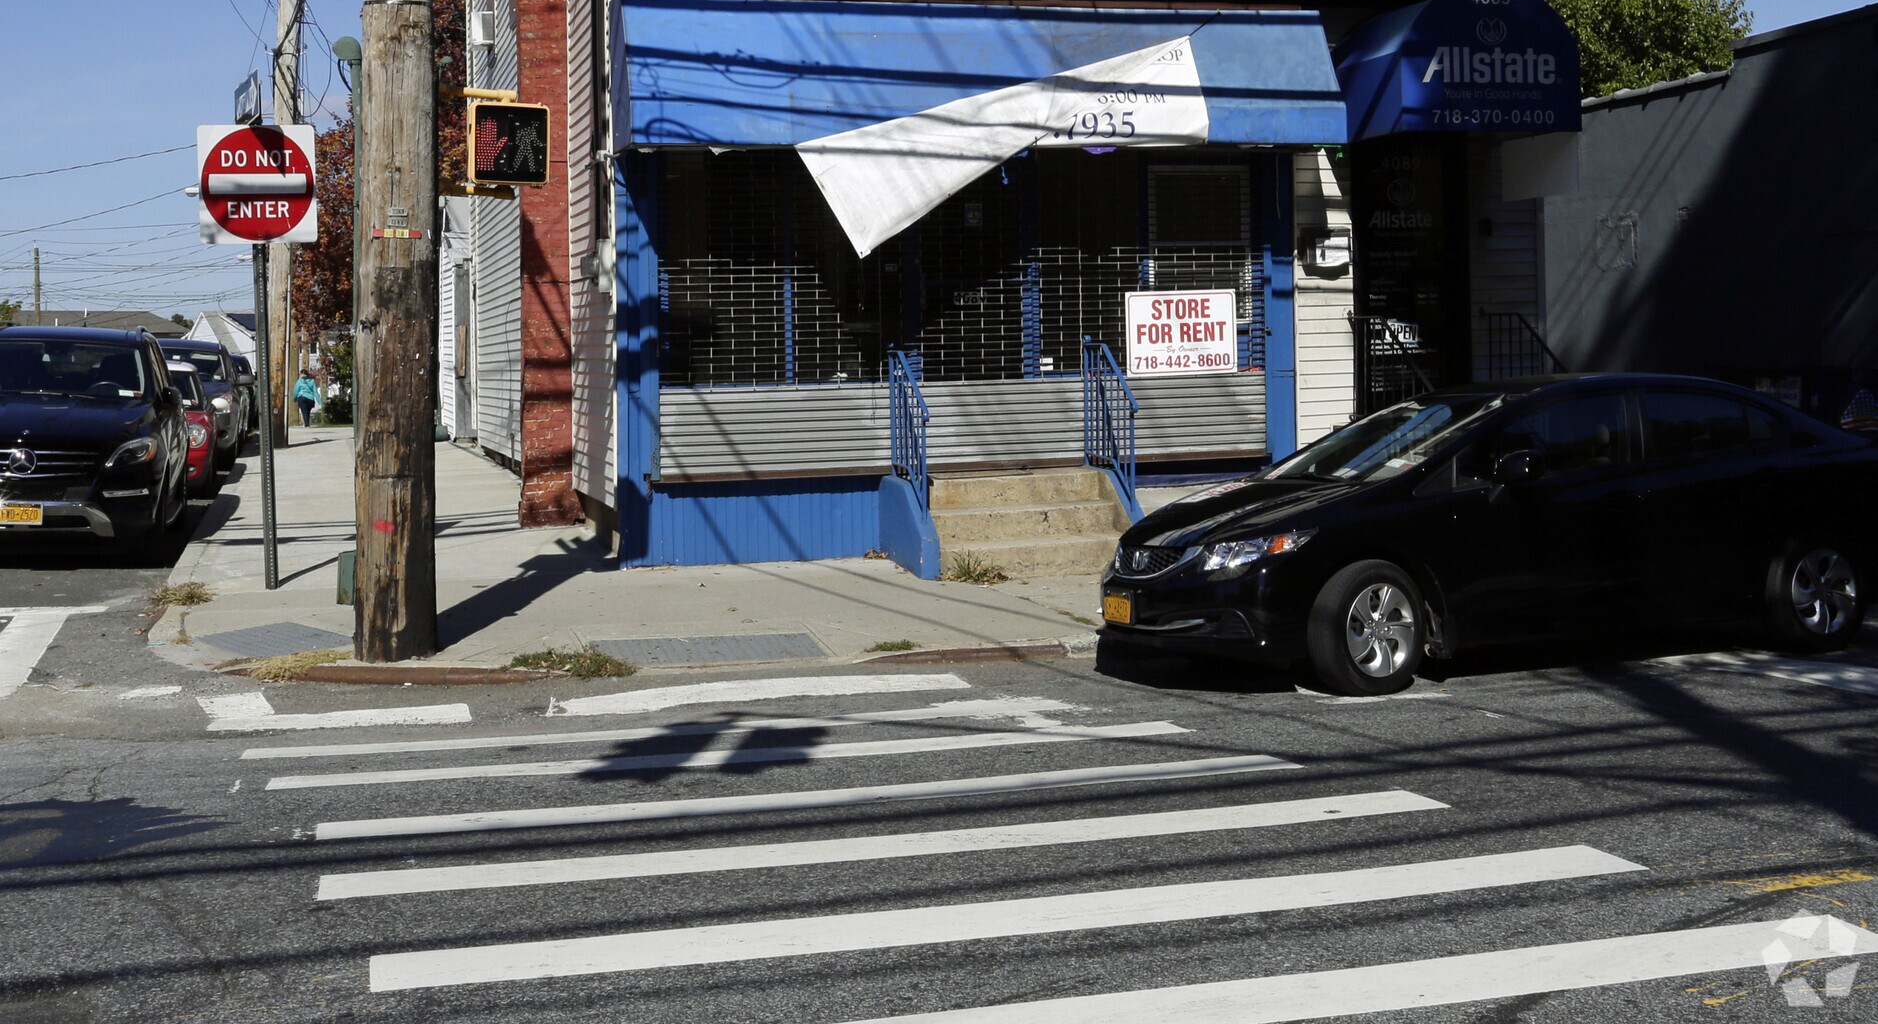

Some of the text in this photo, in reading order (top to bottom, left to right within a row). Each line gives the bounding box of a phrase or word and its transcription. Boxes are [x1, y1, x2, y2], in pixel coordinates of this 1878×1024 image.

[1157, 49, 1183, 62] OP
[1422, 46, 1556, 85] Allstate
[1143, 93, 1167, 104] PM
[1432, 109, 1555, 124] 718-370-0400
[220, 149, 293, 167] DO NOT
[227, 201, 290, 219] ENTER
[1151, 298, 1211, 321] STORE
[1136, 321, 1227, 345] FOR RENT
[1166, 345, 1176, 354] By
[1134, 353, 1231, 370] 718-442-8600
